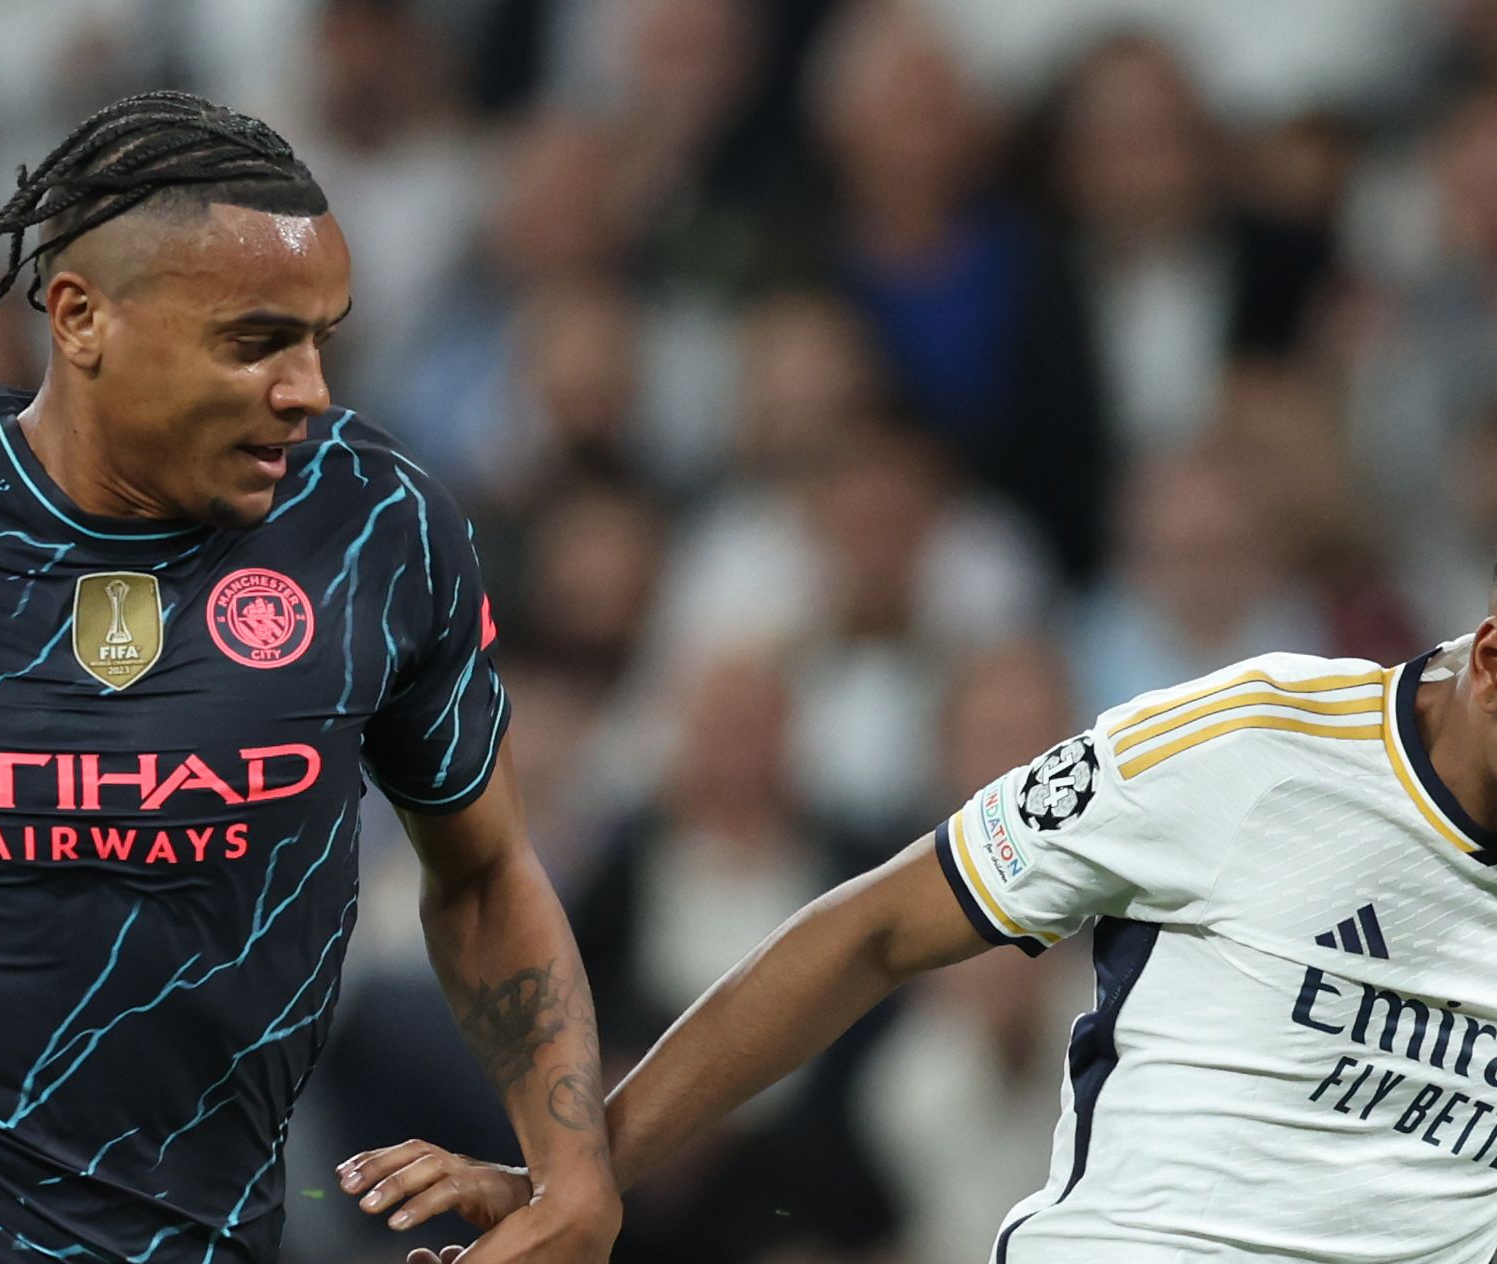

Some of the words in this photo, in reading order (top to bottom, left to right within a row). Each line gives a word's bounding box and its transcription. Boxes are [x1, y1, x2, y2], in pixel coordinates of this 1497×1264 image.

[217, 575, 300, 608] MANCHESTER
[99, 645, 139, 660] FIFA
[250, 648, 282, 660] CITY
[1042, 751, 1077, 809] 14
[985, 788, 1023, 876] NDATION
[1307, 1055, 1406, 1121] FLY
